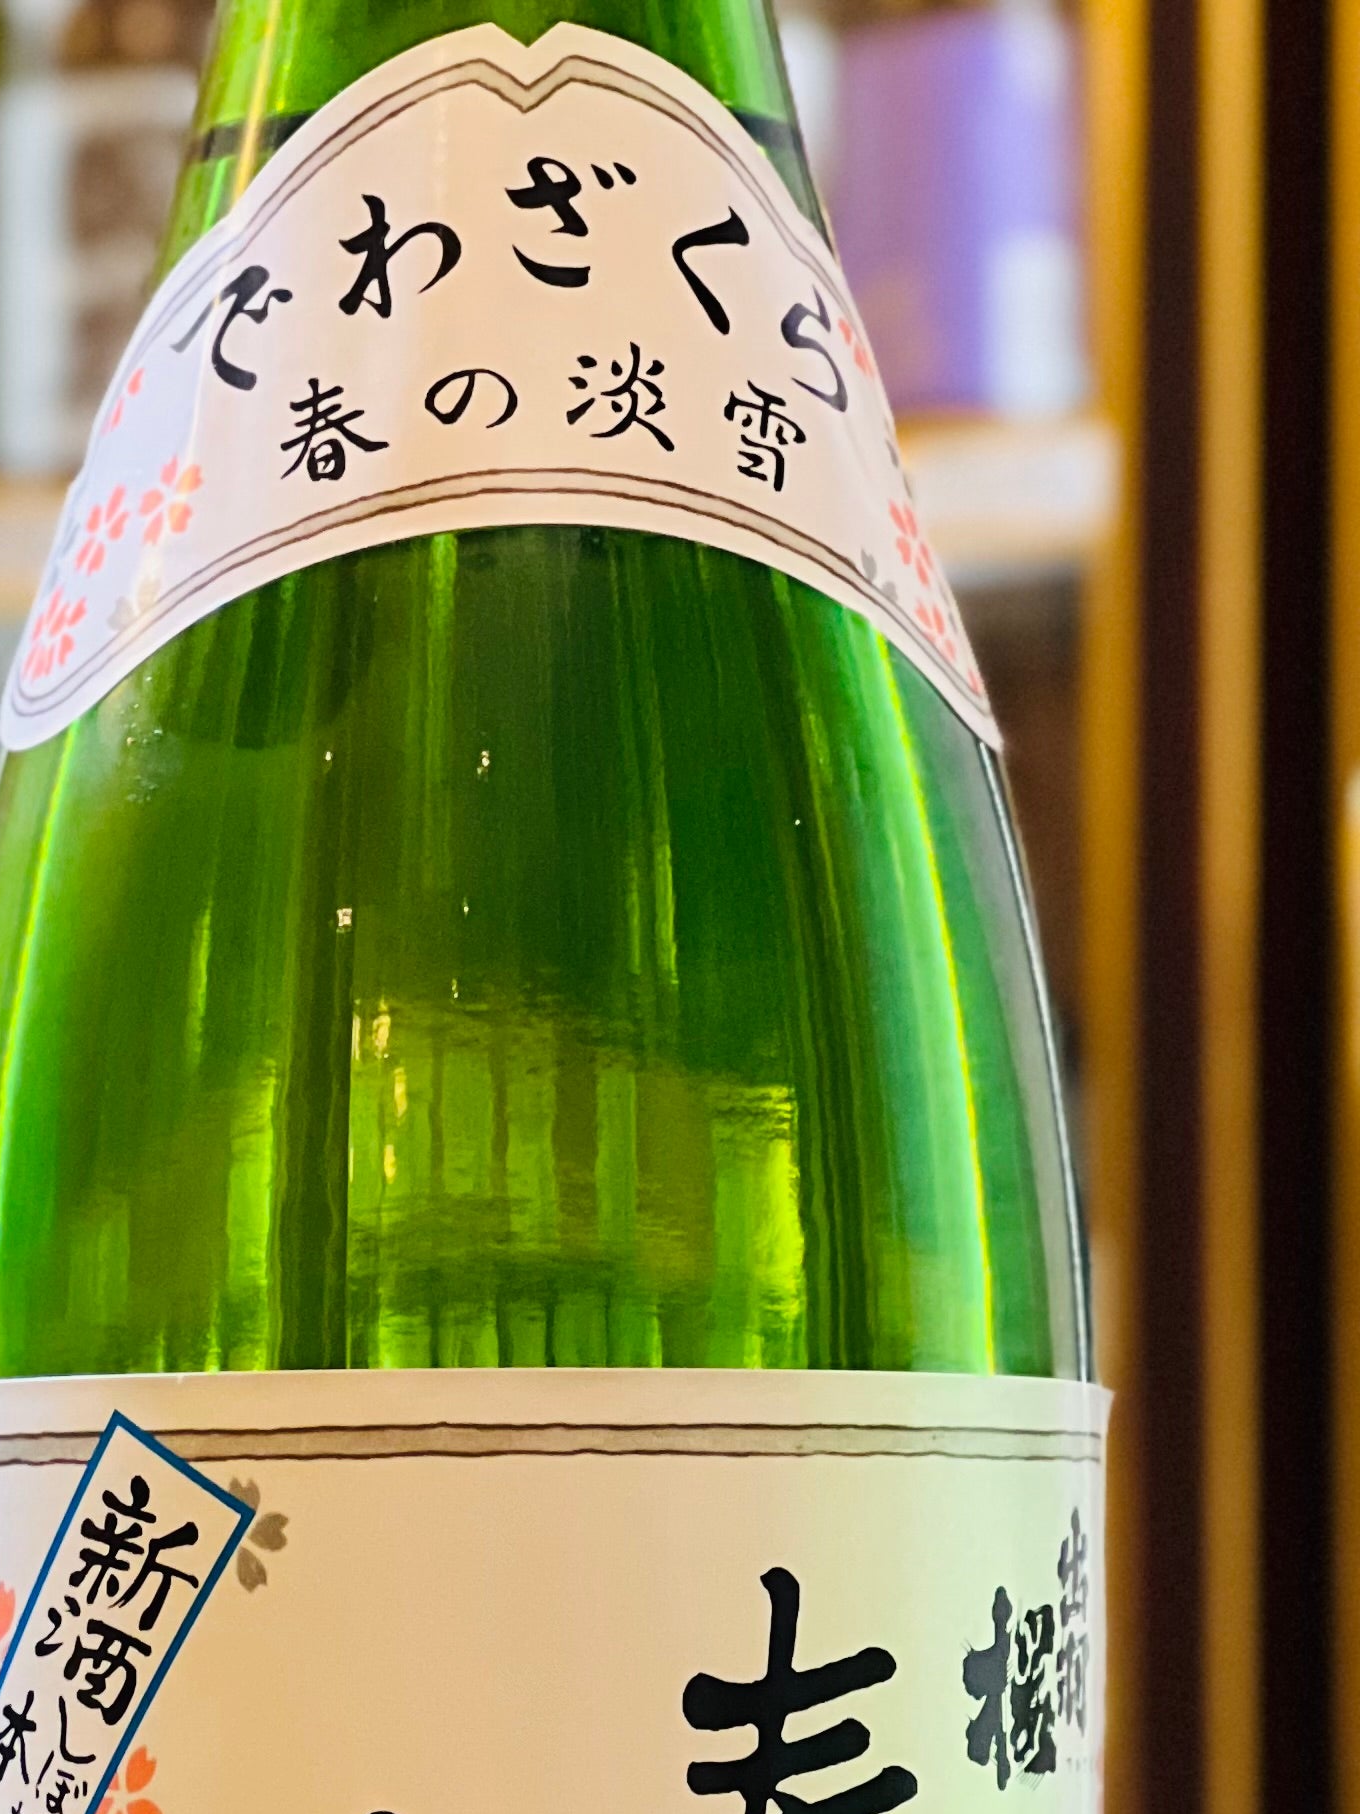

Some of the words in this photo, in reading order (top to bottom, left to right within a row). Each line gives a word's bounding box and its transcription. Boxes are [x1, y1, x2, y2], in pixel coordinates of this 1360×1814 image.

[171, 155, 848, 411] でわざくら
[281, 341, 808, 493] 春の淡雪
[35, 1475, 198, 1725] 新酒
